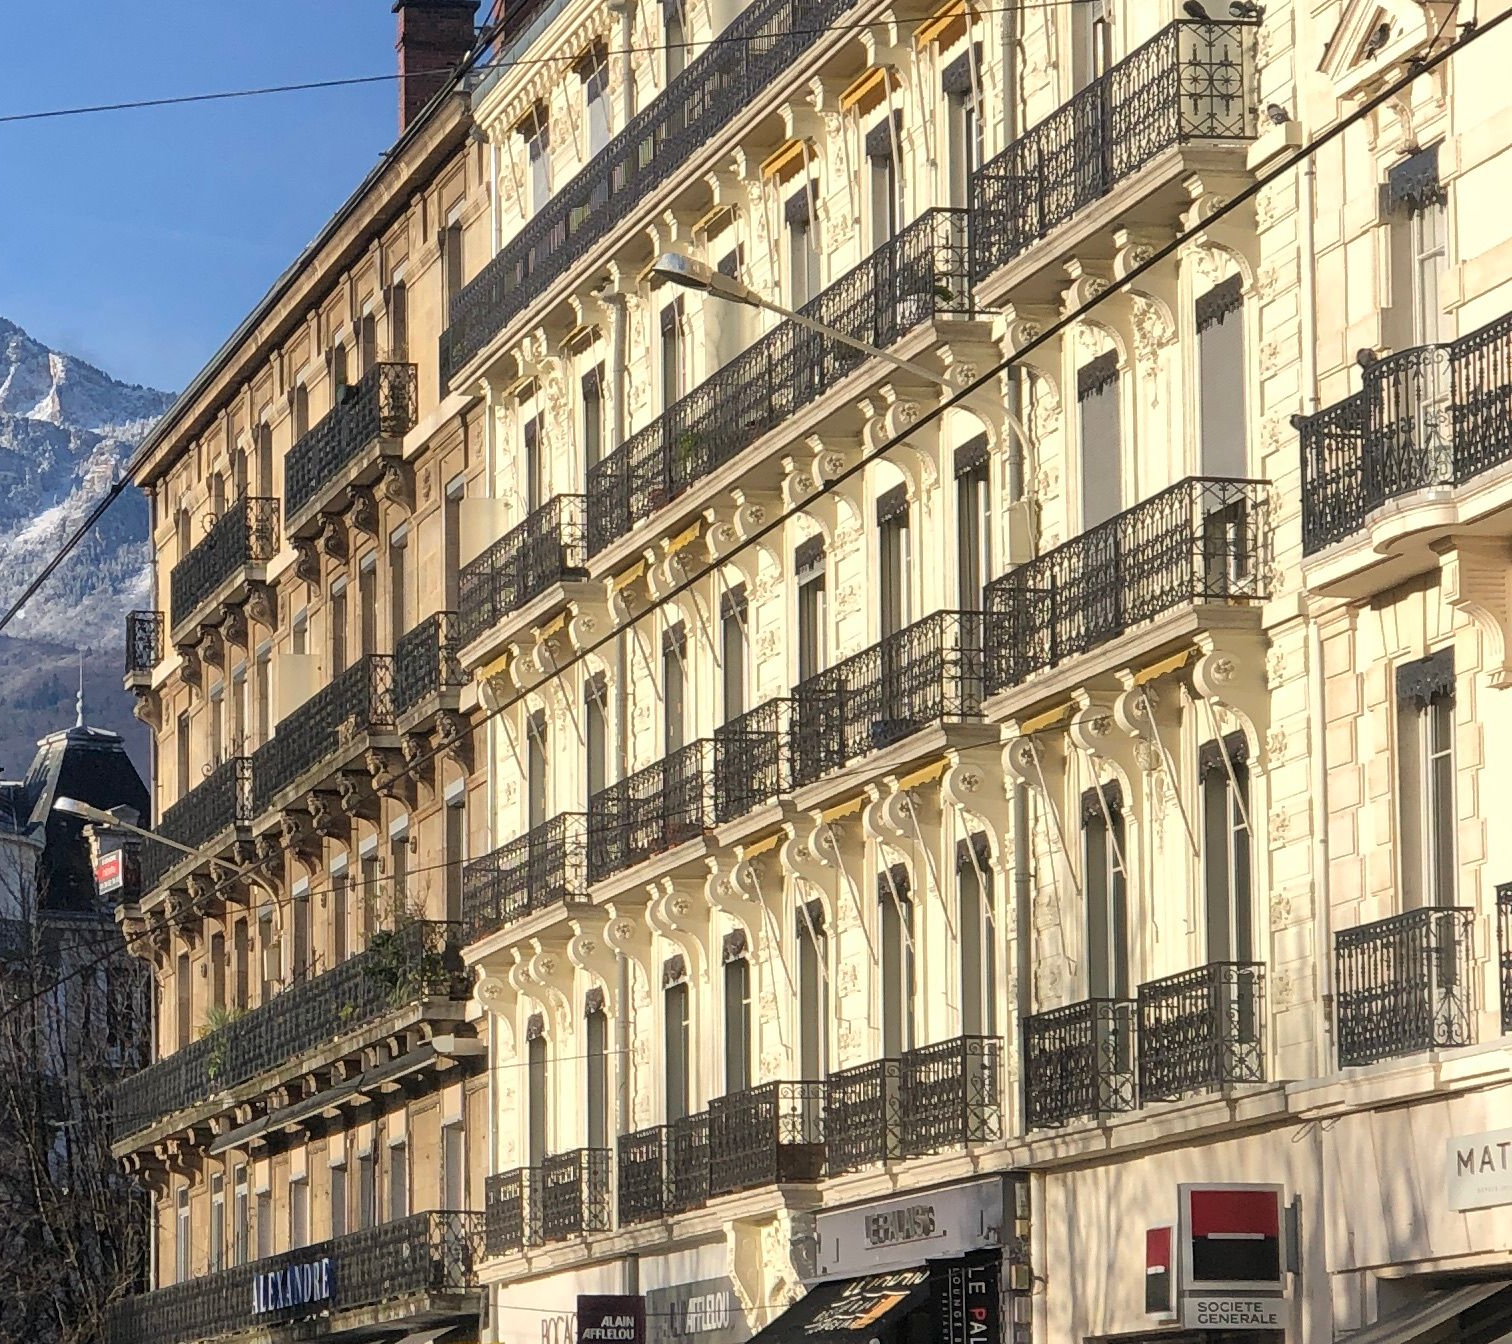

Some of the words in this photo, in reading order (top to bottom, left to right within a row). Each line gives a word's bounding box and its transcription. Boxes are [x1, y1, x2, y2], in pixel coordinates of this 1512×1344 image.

[252, 1258, 330, 1314] ALEXANDRE
[968, 1267, 986, 1294] LE
[685, 1291, 730, 1334] AFFLELOU
[1197, 1301, 1264, 1312] SOCIETE
[600, 1315, 635, 1328] ALAIN
[1197, 1313, 1278, 1324] GENERALE
[582, 1327, 635, 1340] AFFLELOU
